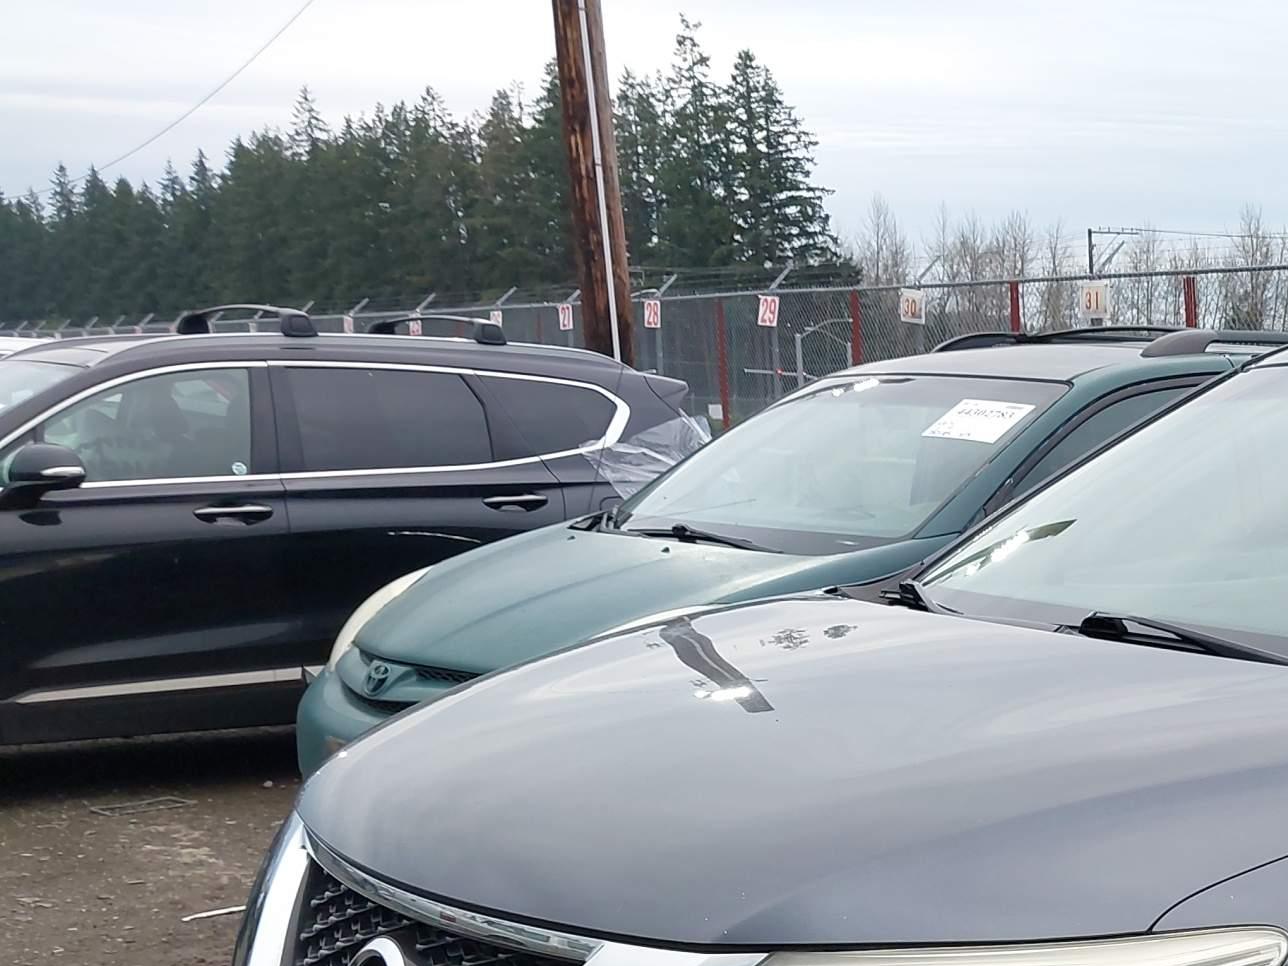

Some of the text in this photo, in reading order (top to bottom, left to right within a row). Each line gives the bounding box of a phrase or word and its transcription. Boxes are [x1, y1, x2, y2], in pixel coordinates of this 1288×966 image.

[760, 298, 776, 324] 29
[904, 298, 917, 316] 30
[1085, 291, 1099, 310] 31
[560, 305, 571, 329] 27
[646, 302, 659, 326] 28
